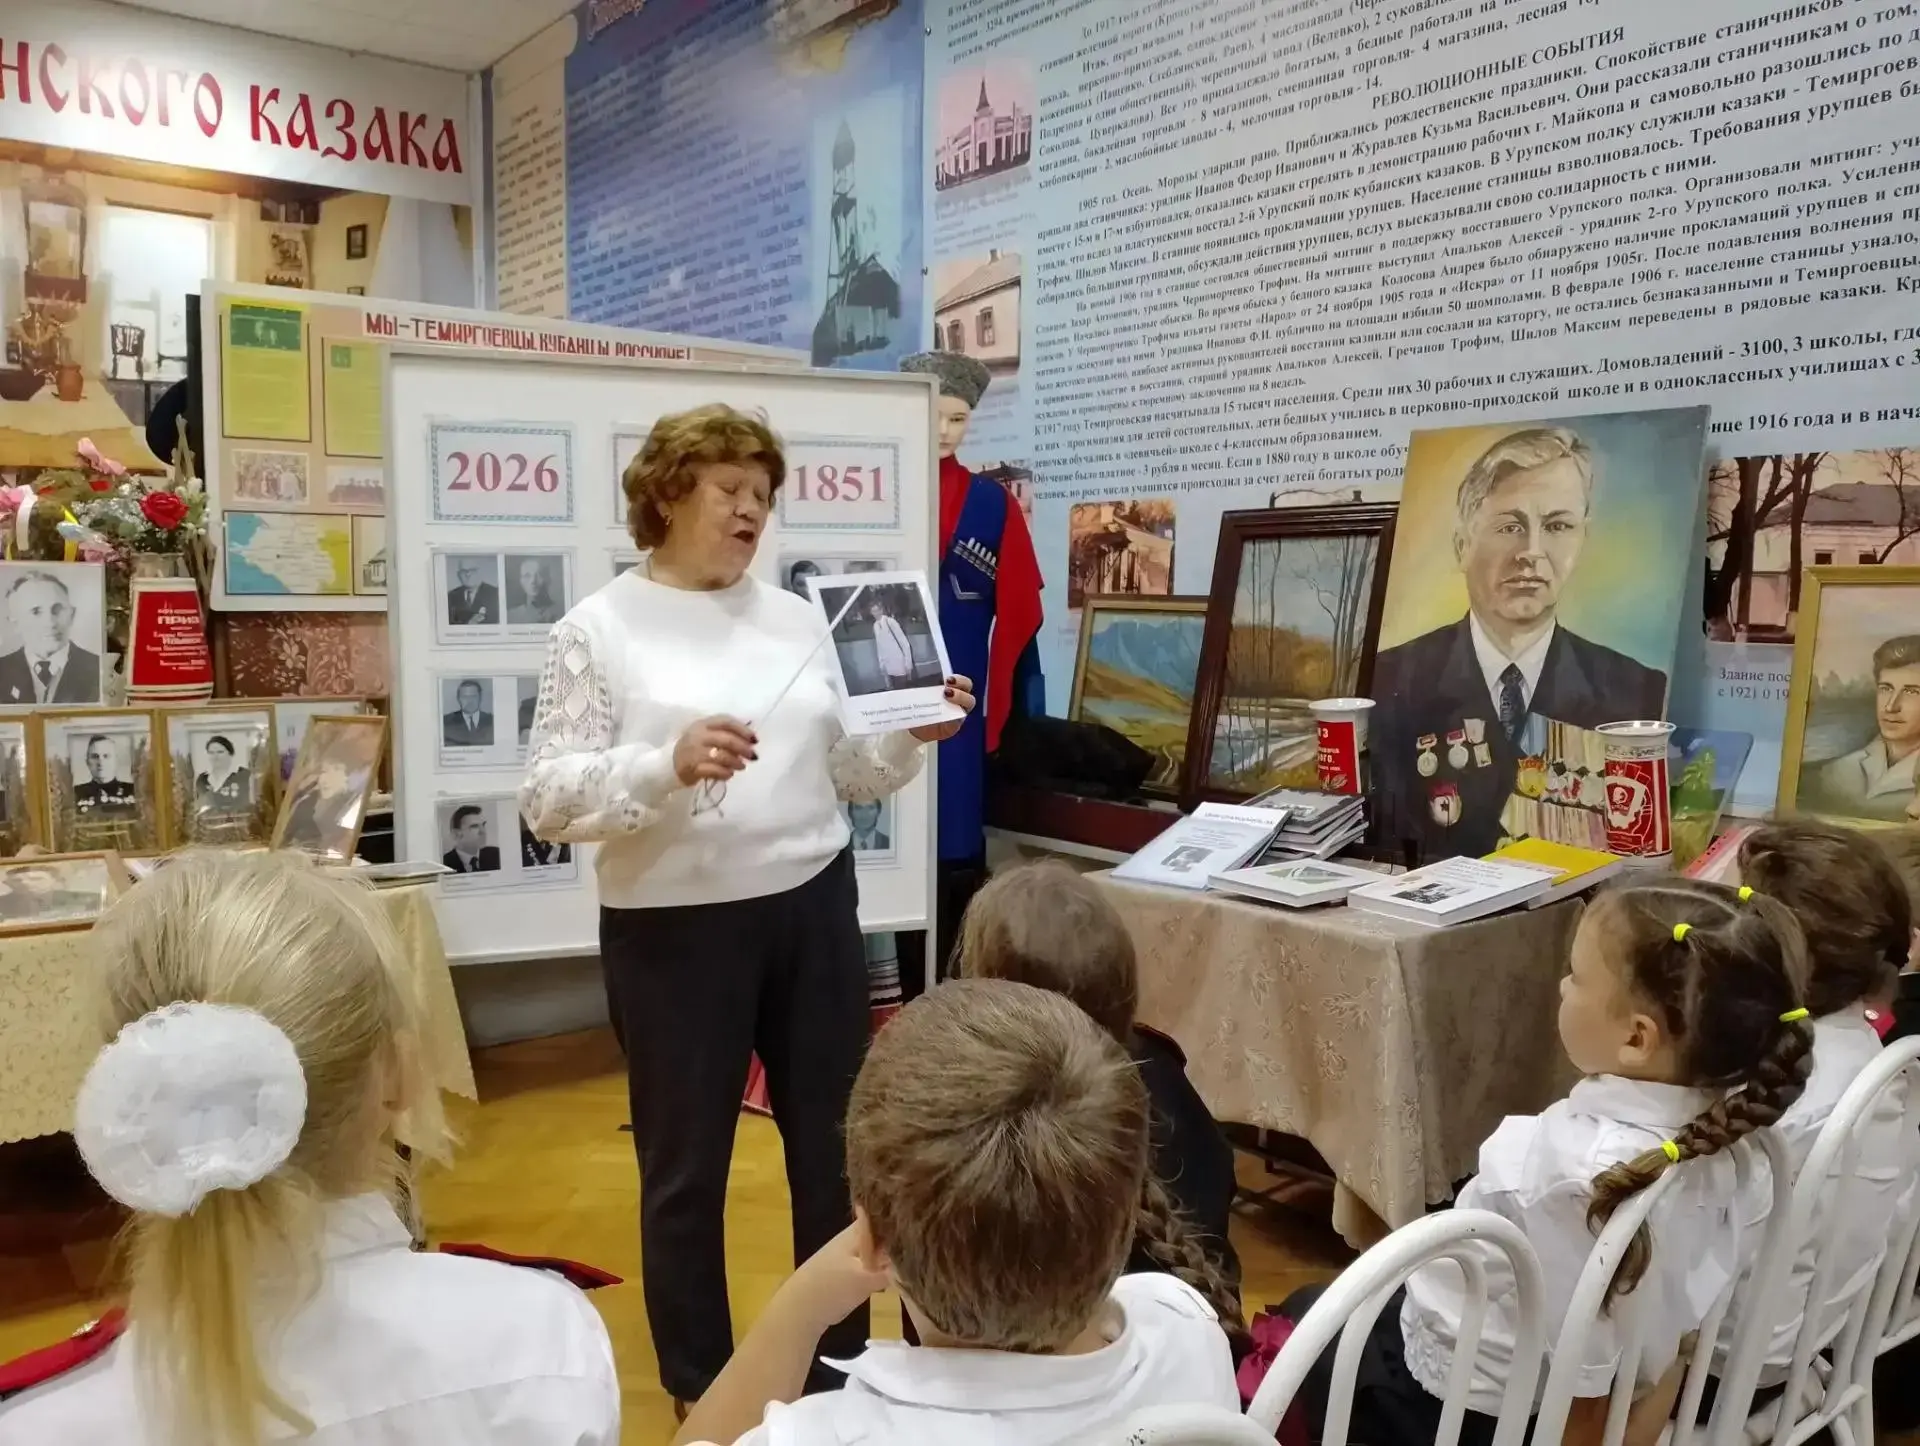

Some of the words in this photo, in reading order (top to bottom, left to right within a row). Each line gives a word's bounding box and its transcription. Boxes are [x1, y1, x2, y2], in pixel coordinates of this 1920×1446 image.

[1480, 0, 1496, 14] на
[1515, 1, 1567, 25] лесная
[1372, 54, 1527, 110] РЕВОЛЮЦИОННЫЕ
[1531, 26, 1624, 64] СОБЫТИЯ
[1384, 89, 1494, 130] рождественские
[1501, 65, 1587, 97] праздники.
[1595, 32, 1707, 71] Спокойствие
[1422, 117, 1472, 140] Кузьма
[1477, 92, 1571, 125] Васильевич.
[1575, 82, 1609, 99] Они
[1615, 56, 1711, 93] рассказали
[1717, 20, 1848, 64] станичникам
[1855, 16, 1867, 29] о
[1875, 4, 1918, 24] том,
[1471, 125, 1531, 152] рабочих
[1535, 122, 1547, 133] г.
[1551, 102, 1625, 129] Майкопа
[1630, 98, 1640, 110] и
[1649, 70, 1756, 105] самовольно
[1762, 42, 1871, 82] разошлись
[1878, 33, 1903, 50] по
[249, 85, 463, 174] КАЗАКА
[1411, 181, 1483, 205] Население
[1487, 165, 1552, 188] станицы
[1557, 138, 1684, 173] взволновалось.
[1689, 110, 1801, 145] Требования
[1807, 89, 1892, 121] урупцев
[1426, 159, 1485, 181] казаков.
[1490, 151, 1500, 166] В
[1505, 135, 1581, 163] Урупском
[1587, 123, 1635, 144] полку
[1640, 104, 1715, 131] служили
[1721, 87, 1786, 113] казаки
[1397, 200, 1492, 229] высказывали
[1495, 191, 1533, 209] свою
[1537, 168, 1647, 200] солидарность
[1651, 165, 1660, 176] с
[1665, 154, 1716, 174] ними.
[1508, 225, 1563, 246] Алексей
[1580, 212, 1641, 236] урядник
[1647, 206, 1677, 220] 2-го
[1684, 188, 1769, 214] Урупского
[1777, 178, 1832, 197] полка.
[1548, 195, 1623, 219] Урупского
[1629, 185, 1677, 203] полка.
[1685, 160, 1801, 192] Организовали
[1810, 144, 1881, 168] митинг:
[1527, 239, 1609, 262] обнаружено
[1614, 227, 1676, 247] наличие
[1682, 205, 1789, 236] прокламаций
[1796, 193, 1868, 219] урупцев
[1875, 190, 1886, 201] и
[1531, 267, 1543, 281] 11
[1550, 260, 1599, 278] ноября
[1606, 250, 1648, 268] 1905г.
[1655, 244, 1700, 260] После
[1707, 227, 1801, 252] подавления
[1810, 212, 1893, 236] волнения
[1496, 309, 1551, 325] каторгу,
[1555, 305, 1571, 317] не
[1574, 296, 1638, 313] остались
[1642, 276, 1773, 304] безнаказанными
[1779, 274, 1789, 285] и
[1797, 255, 1917, 282] Темиргоевцы.
[1551, 284, 1561, 297] В
[1565, 277, 1624, 298] феврале
[1631, 267, 1662, 285] 1906
[1668, 269, 1679, 279] г.
[1685, 255, 1765, 277] население
[1770, 243, 1845, 264] станицы
[1850, 232, 1919, 255] узнало,
[1511, 327, 1558, 342] Шилов
[1564, 318, 1621, 334] Максим
[1628, 305, 1716, 327] переведены
[1724, 303, 1733, 314] в
[1741, 293, 1811, 315] рядовые
[1820, 284, 1886, 302] казаки.
[1401, 387, 1559, 416] церковно-приходской
[1567, 384, 1620, 399] школе
[1624, 382, 1634, 393] и
[1639, 381, 1649, 392] в
[1654, 367, 1783, 391] одноклассных
[1788, 356, 1890, 381] училищах
[1895, 355, 1905, 367] с
[1435, 375, 1493, 394] рабочих
[1496, 374, 1505, 384] и
[1509, 364, 1593, 384] служащих.
[1596, 345, 1723, 374] Домовладений
[1740, 338, 1788, 358] 3100,
[1792, 336, 1803, 352] 3
[1810, 331, 1888, 350] школы,
[1749, 413, 1788, 430] 1916
[1794, 413, 1834, 428] года
[1841, 412, 1852, 424] и
[1859, 411, 1870, 423] в
[446, 451, 560, 492] 2026
[793, 465, 888, 502] 1851
[1720, 667, 1764, 681] Здание
